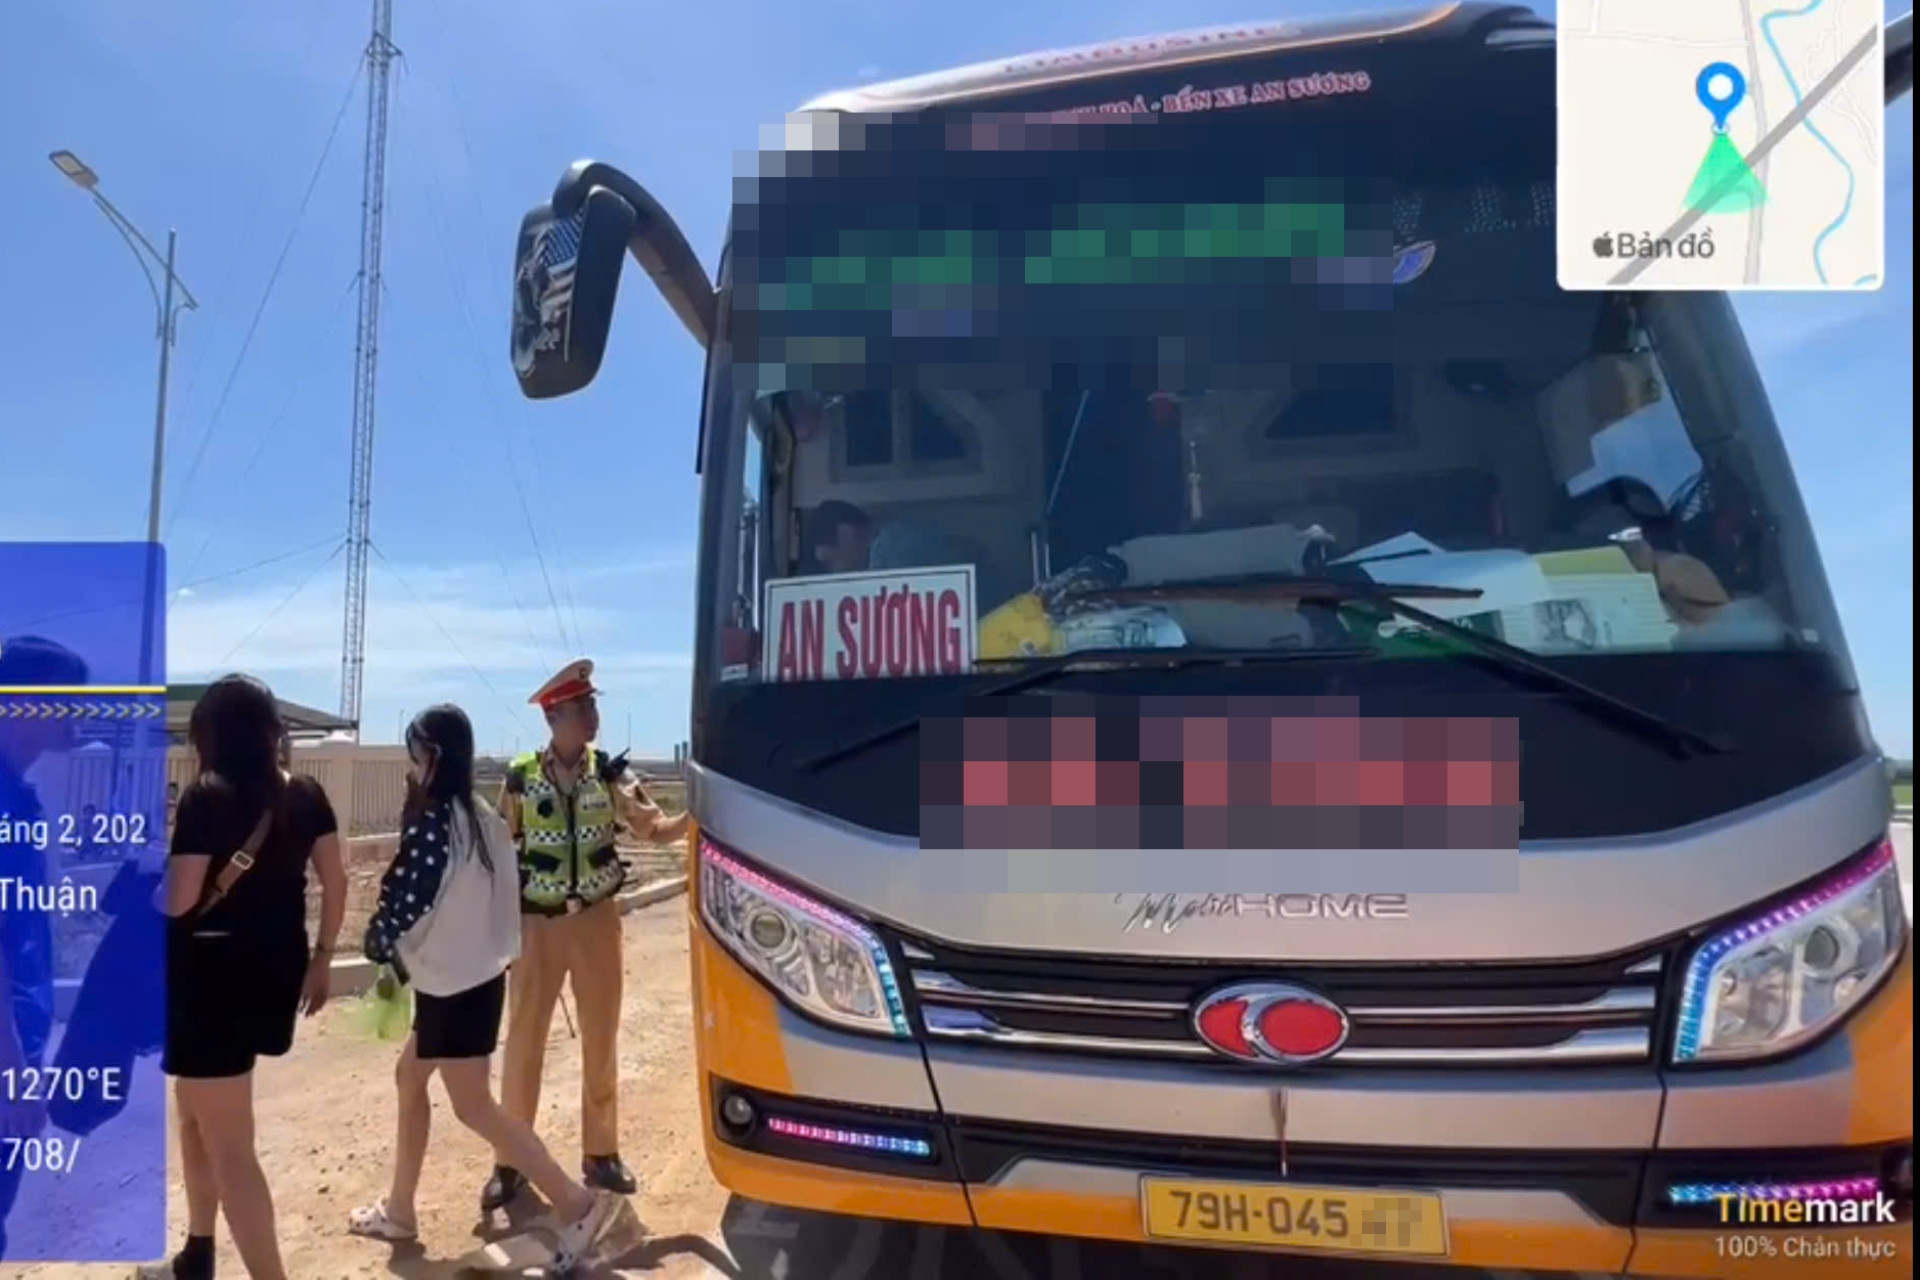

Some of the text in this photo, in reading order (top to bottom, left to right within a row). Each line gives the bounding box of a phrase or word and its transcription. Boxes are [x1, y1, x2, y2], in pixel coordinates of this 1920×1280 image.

[1161, 84, 1211, 113] BẾN
[1214, 85, 1248, 107] XE
[1251, 80, 1285, 102] AN
[1287, 71, 1371, 98] SƯƠNG
[778, 583, 961, 680] AN SƯƠNG
[1169, 1191, 1422, 1246] 79H-045
